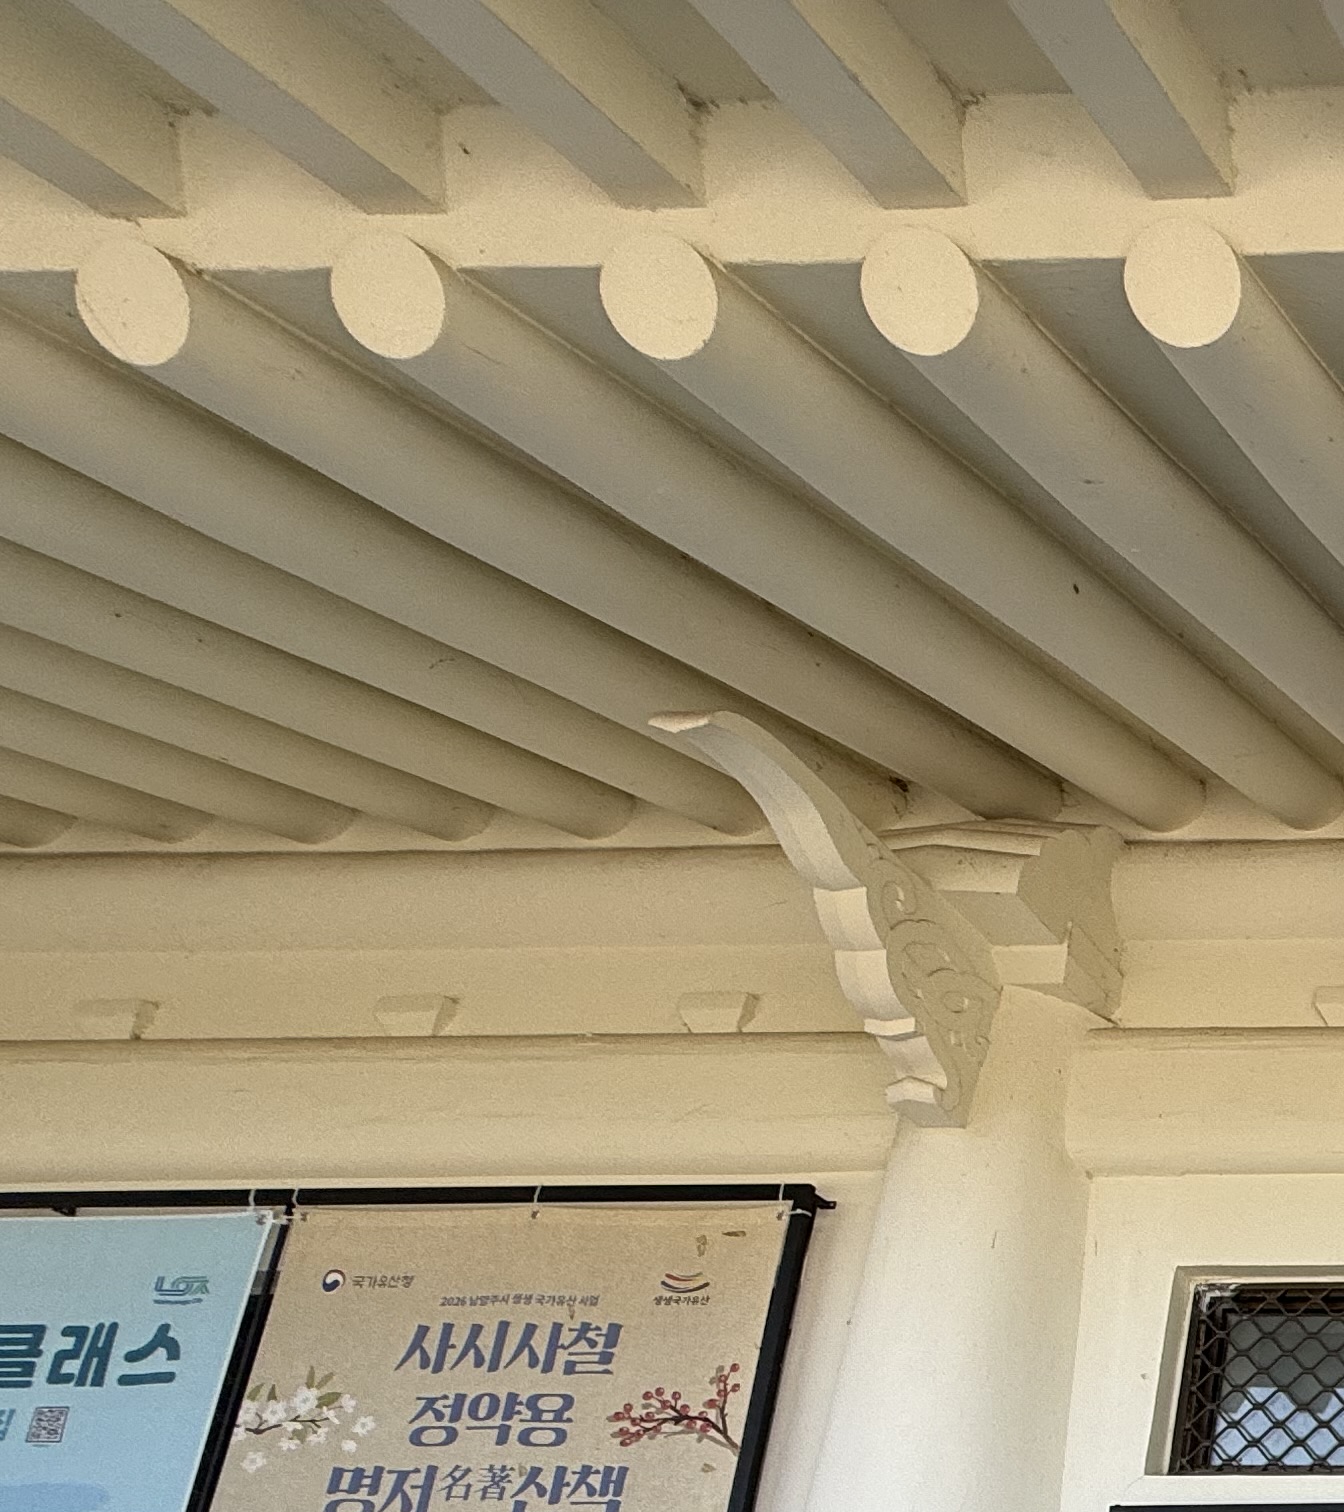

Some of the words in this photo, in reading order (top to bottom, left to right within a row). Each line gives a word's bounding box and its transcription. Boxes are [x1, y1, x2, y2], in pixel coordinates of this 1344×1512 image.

[352, 1275, 414, 1289] 국가유산청
[535, 1294, 577, 1307] 국가유산
[394, 1320, 622, 1376] 사시사철
[408, 1392, 574, 1447] 정약용
